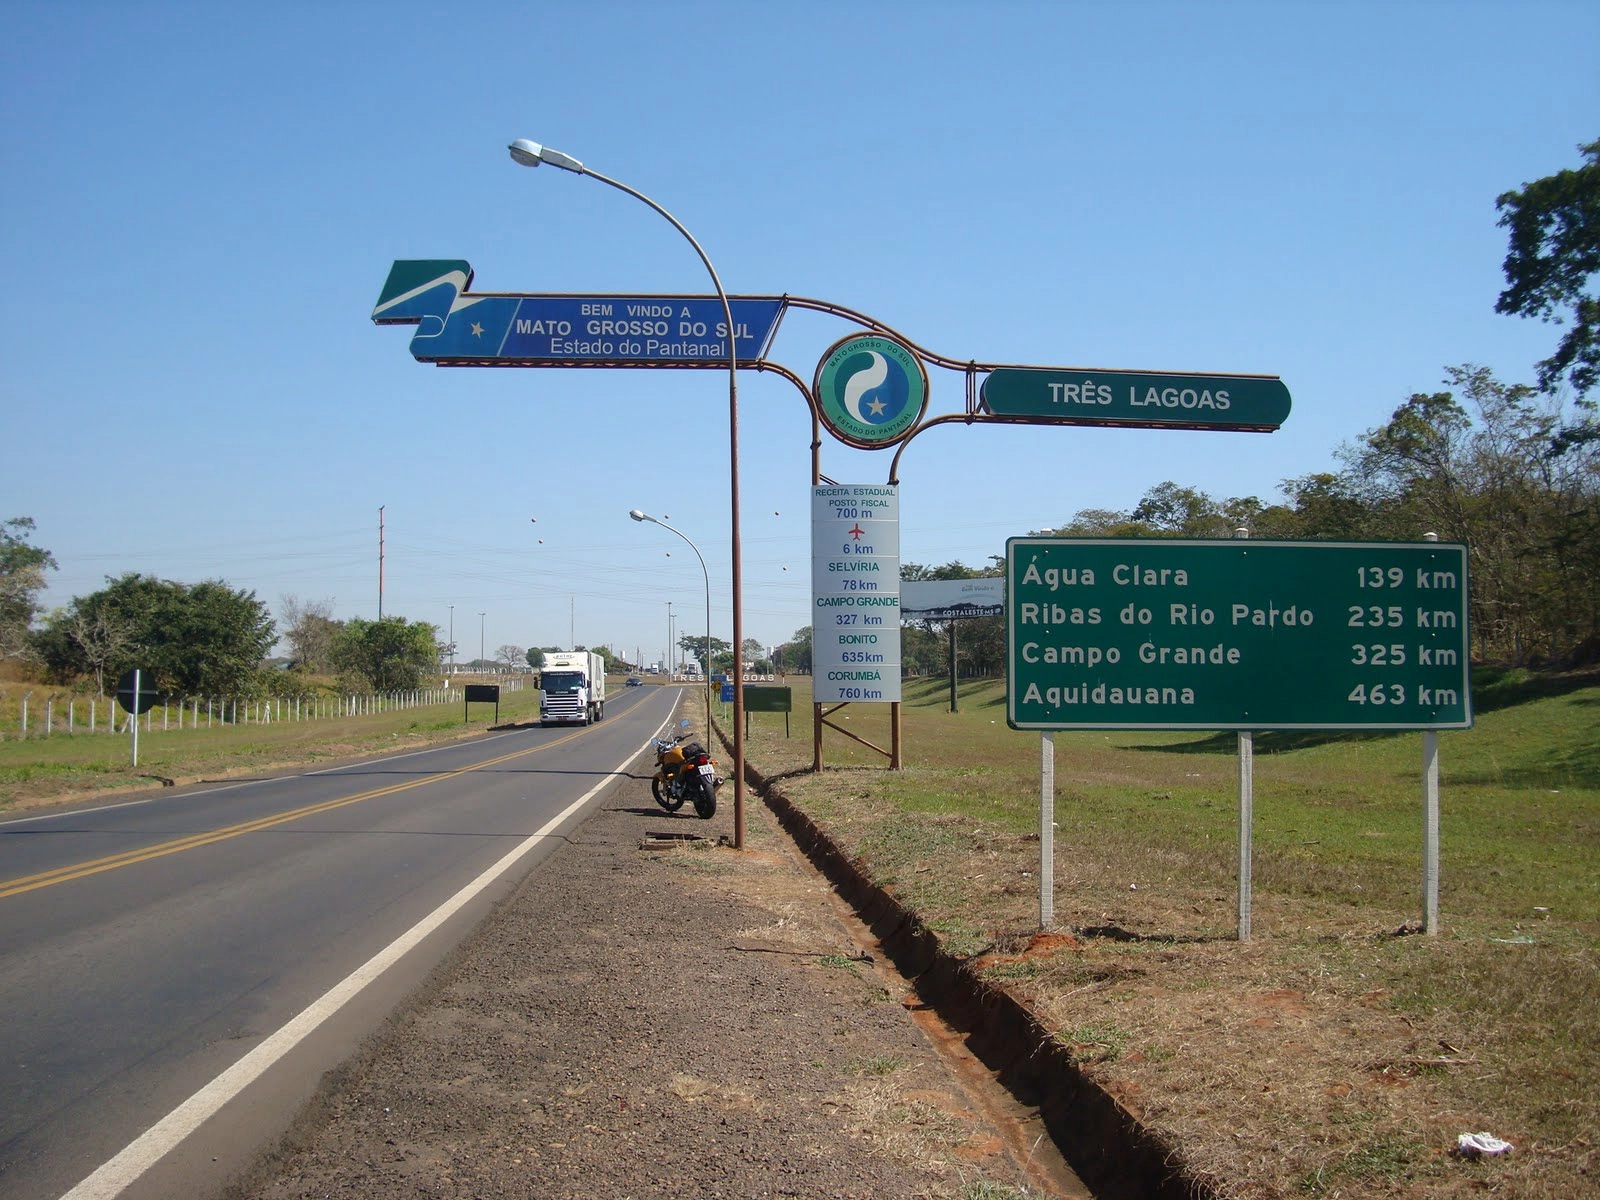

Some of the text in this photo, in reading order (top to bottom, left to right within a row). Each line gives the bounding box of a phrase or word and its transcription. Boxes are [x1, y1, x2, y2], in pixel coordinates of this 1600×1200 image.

[581, 304, 691, 318] BEM VINDO A
[516, 319, 572, 336] MATO
[586, 320, 669, 336] GROSSO
[679, 321, 707, 337] DO
[551, 337, 725, 356] Estado do Pantanal
[830, 341, 911, 368] MATO GROSSO DO SUL
[1048, 380, 1231, 410] TRÊS LAGOAS
[836, 415, 863, 435] ESTADO
[879, 412, 912, 435] PANTANAL
[815, 488, 896, 497] RECEITA ESTADUAL
[829, 499, 890, 508] POSTO FISCAL
[836, 508, 873, 518] 700 m
[843, 543, 874, 554] 6 km
[828, 560, 880, 572] SELVÍRIA
[1021, 555, 1456, 591] Água Clara 139 km
[842, 579, 878, 590] 78 km
[816, 597, 899, 607] CAMPO GRANDE
[836, 614, 882, 625] 327 km
[1021, 603, 1457, 628] Ribas do Rio Pardo 235 km
[839, 634, 878, 645] BONITO
[842, 651, 884, 663] 635 km
[1022, 642, 1457, 668] Campo Grande 325 km
[828, 669, 881, 681] CORUMBÁ
[839, 687, 882, 699] 760 km
[1022, 682, 1457, 709] Aquidauana 463 km
